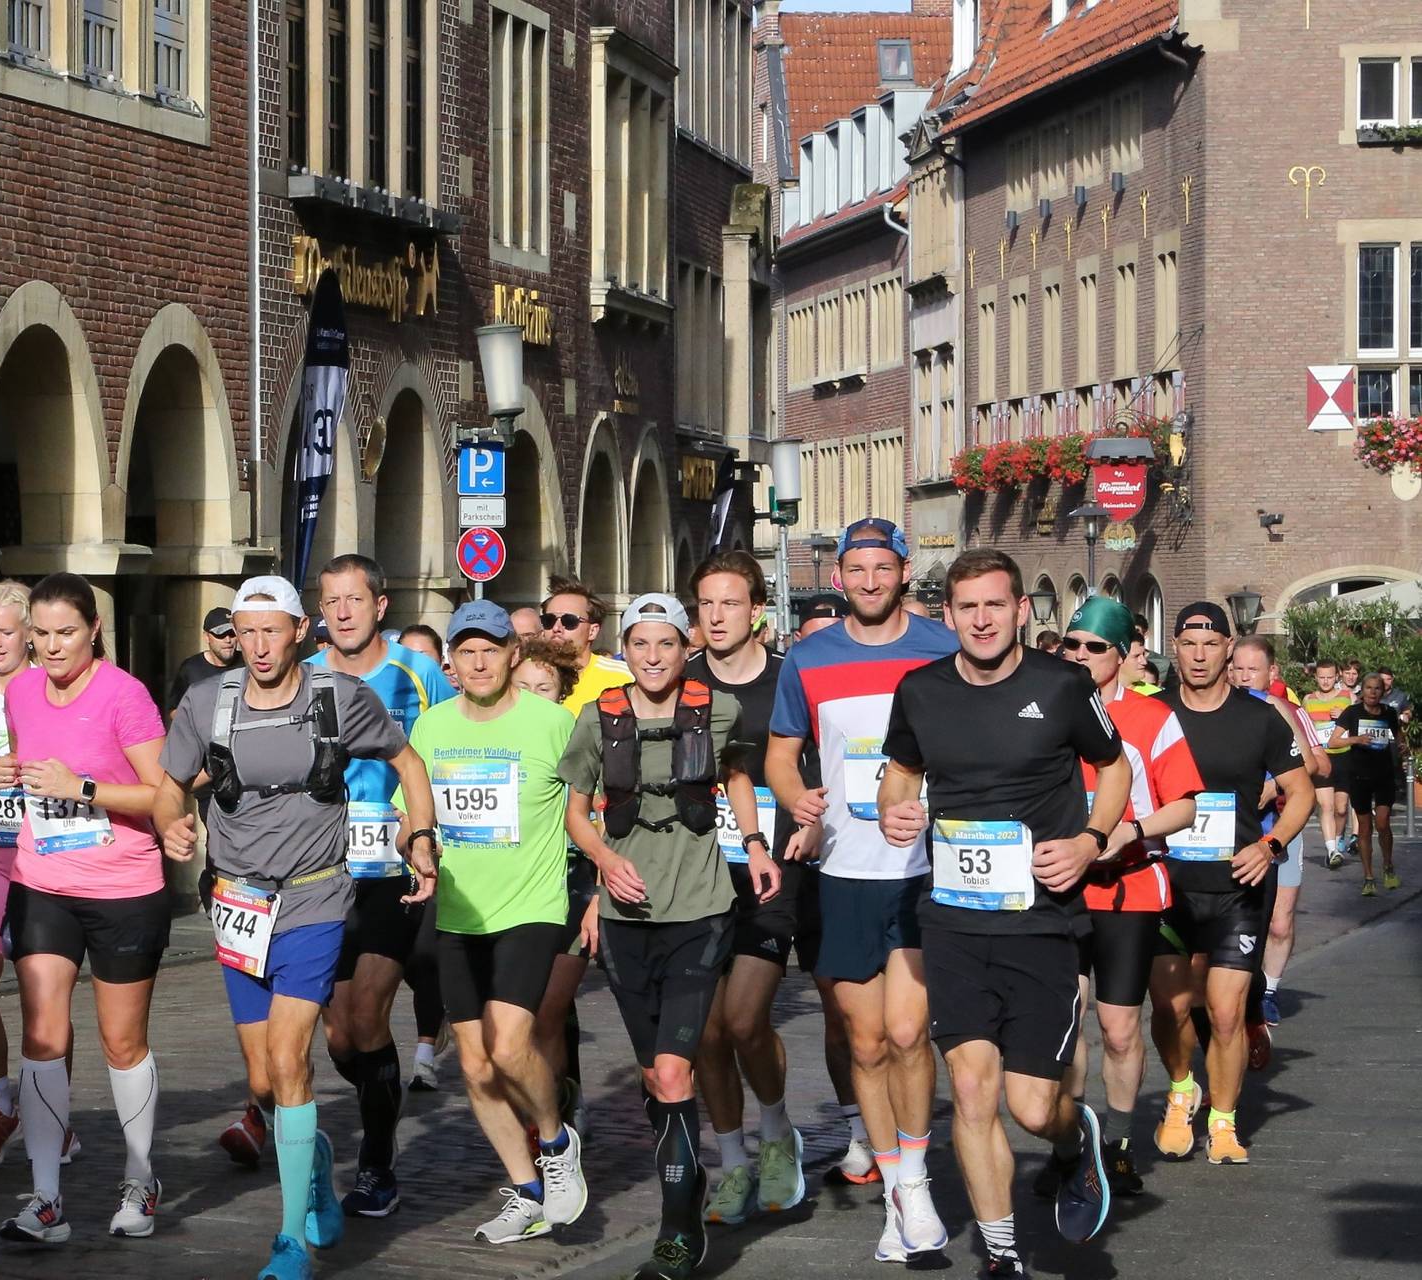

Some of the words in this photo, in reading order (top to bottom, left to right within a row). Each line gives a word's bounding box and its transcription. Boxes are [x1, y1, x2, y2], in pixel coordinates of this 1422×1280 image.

[469, 448, 493, 487] P
[463, 513, 502, 521] Parkschein
[434, 747, 482, 757] Bentheimer
[484, 747, 522, 759] Waldlauf
[442, 788, 498, 811] 1595
[458, 812, 482, 820] Volker
[63, 820, 76, 828] Ute
[722, 832, 743, 840] Onno
[955, 831, 995, 840] Marathon
[997, 831, 1018, 840] 2023
[959, 848, 992, 875] 53
[962, 875, 990, 885] Tobias
[222, 889, 253, 905] Marathon
[215, 903, 258, 938] 2744
